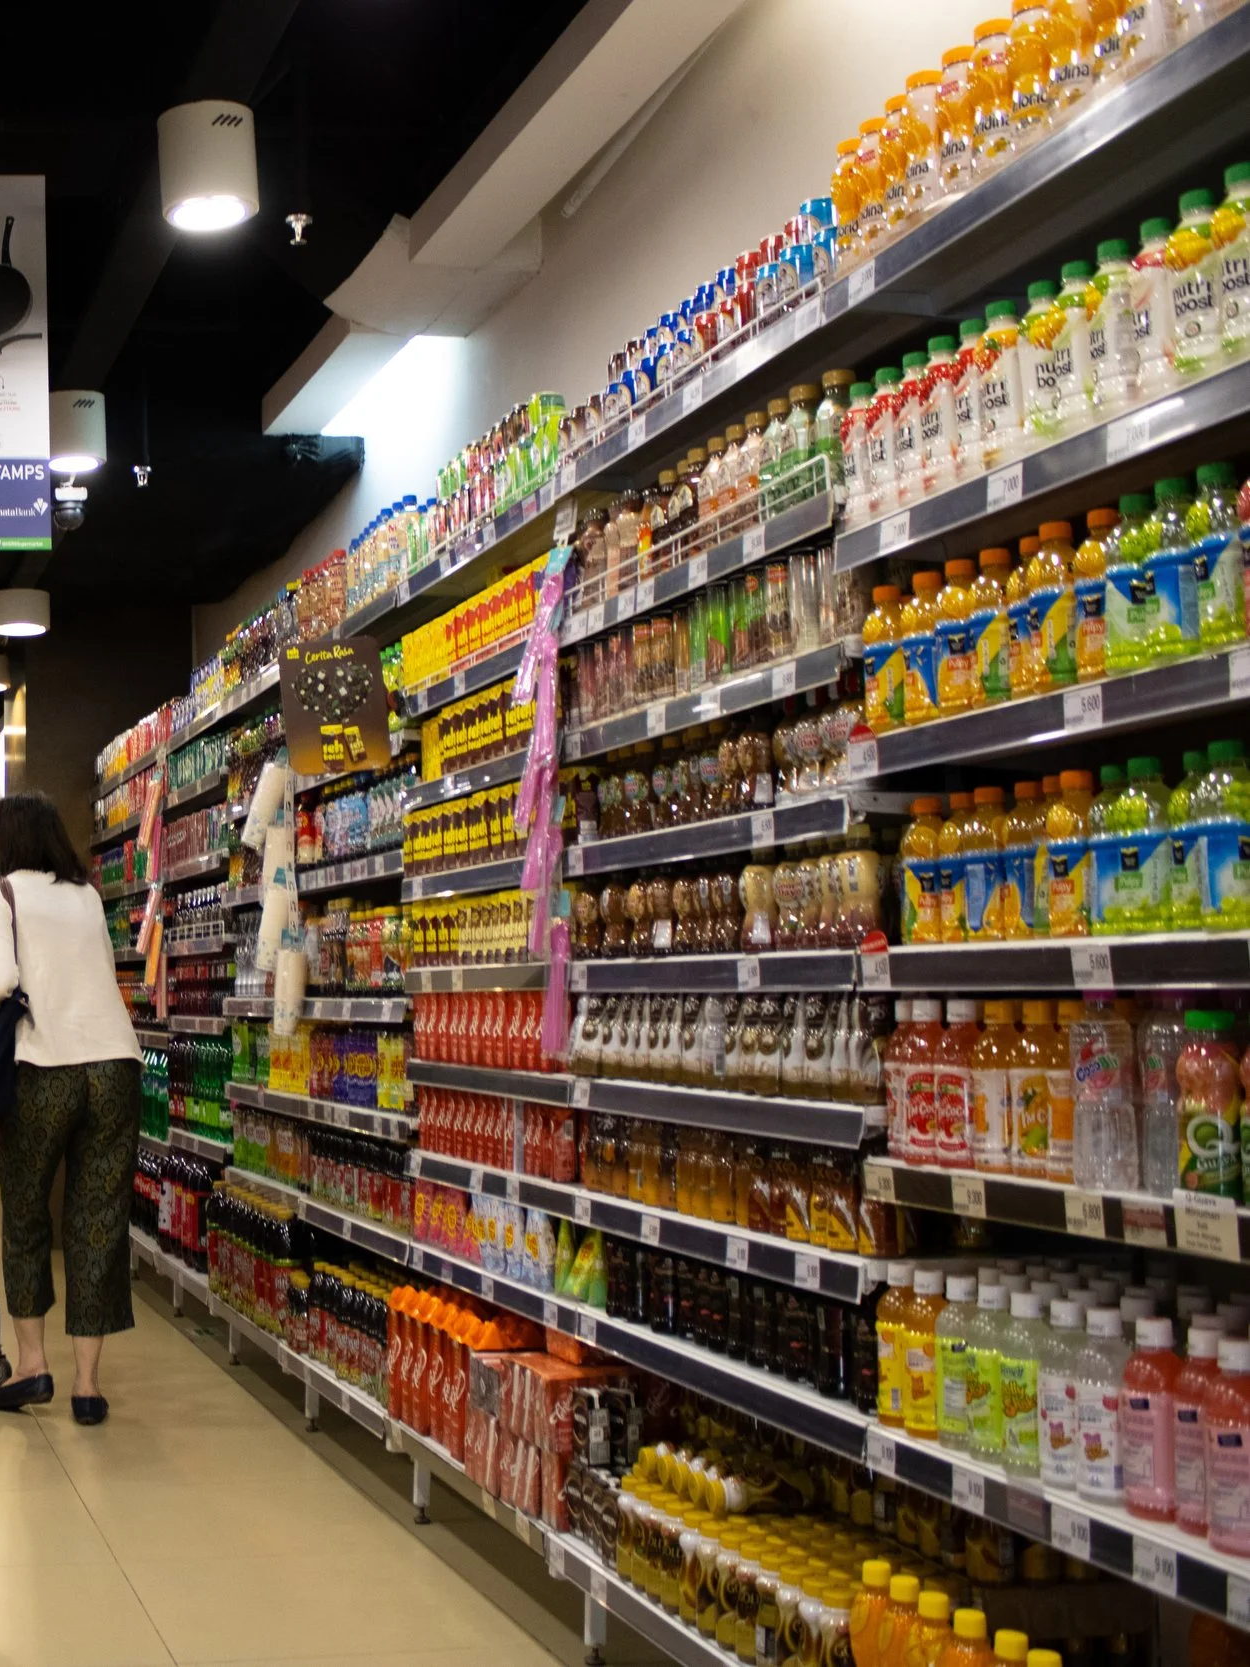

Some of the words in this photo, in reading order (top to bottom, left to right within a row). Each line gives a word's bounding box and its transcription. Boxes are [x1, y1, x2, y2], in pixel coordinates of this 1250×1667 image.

[1172, 280, 1212, 301] nutri
[1174, 294, 1213, 318] boost
[305, 649, 333, 665] Cerita
[333, 645, 354, 659] Rasa
